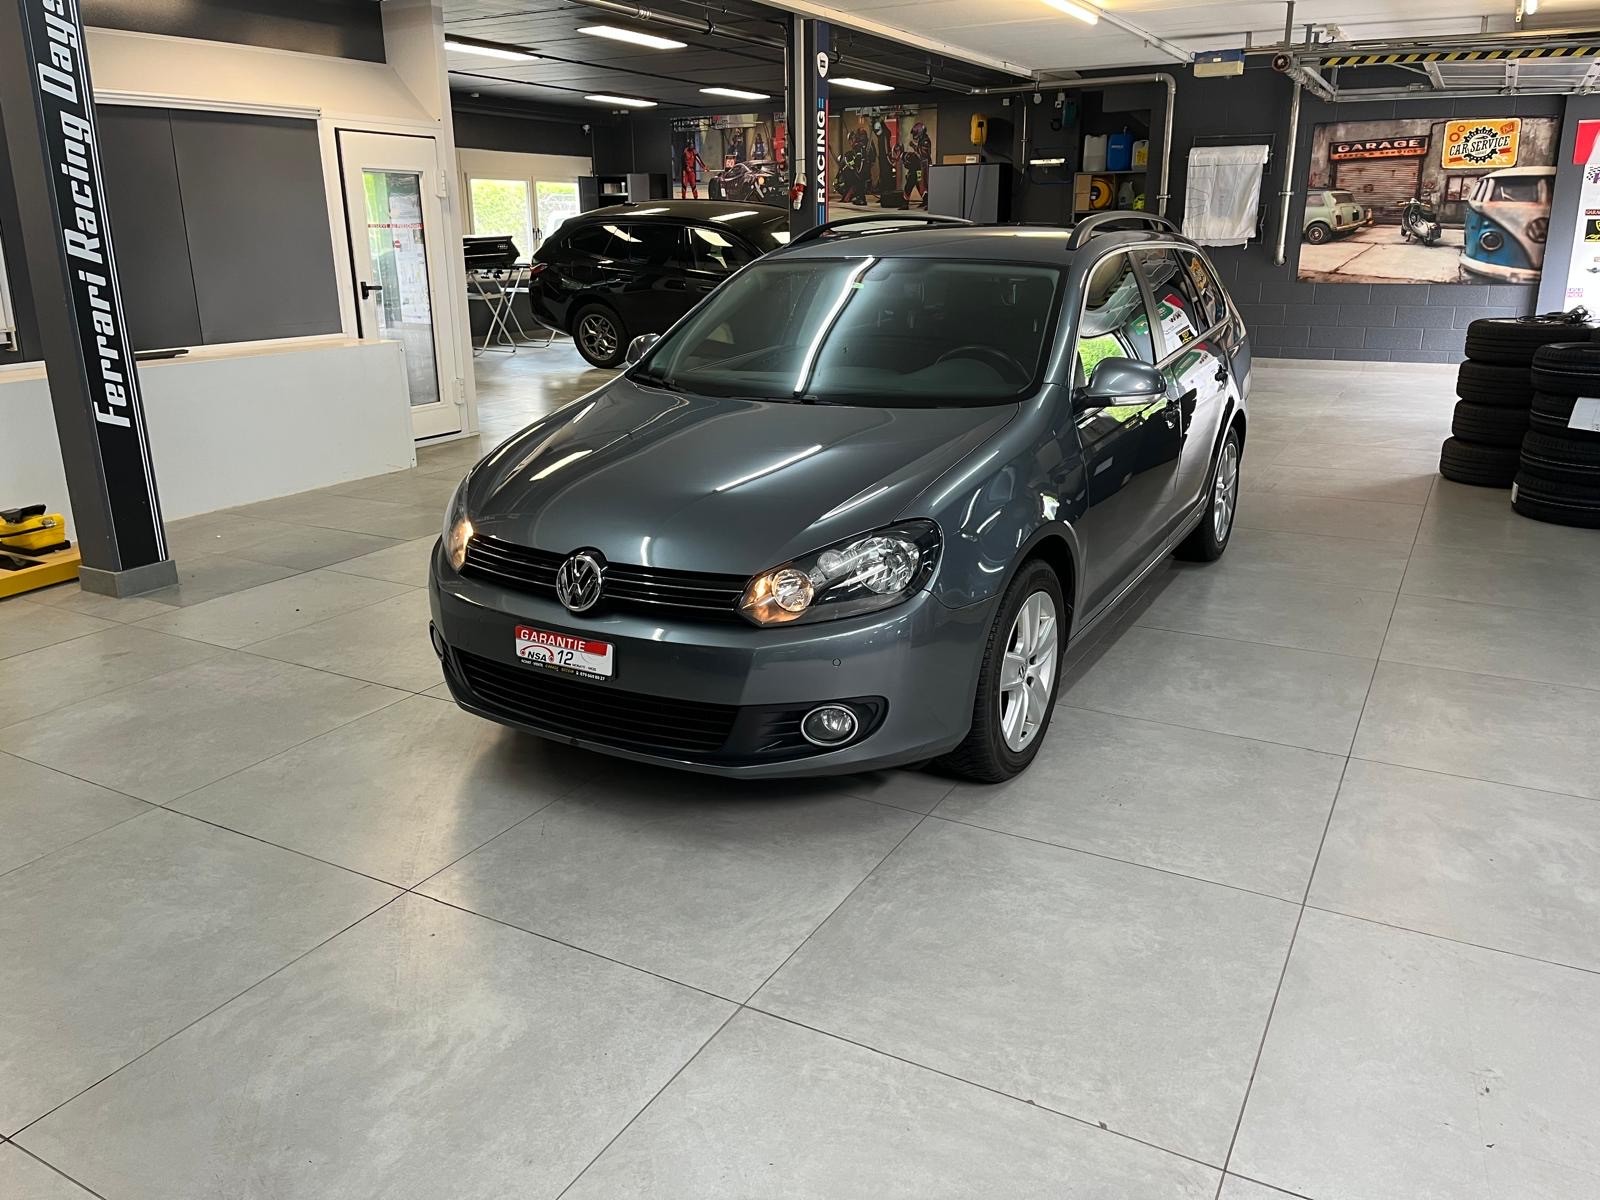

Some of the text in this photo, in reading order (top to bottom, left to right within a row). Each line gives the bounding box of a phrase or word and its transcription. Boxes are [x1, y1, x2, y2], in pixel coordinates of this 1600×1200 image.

[817, 110, 826, 203] RACING
[1337, 139, 1420, 153] GARAGE
[1449, 135, 1510, 156] CAR SERVICE
[60, 110, 103, 264] Racing
[78, 269, 131, 428] Ferrari
[520, 629, 586, 652] GARANTIE
[527, 651, 547, 662] NSA
[557, 650, 574, 666] 12
